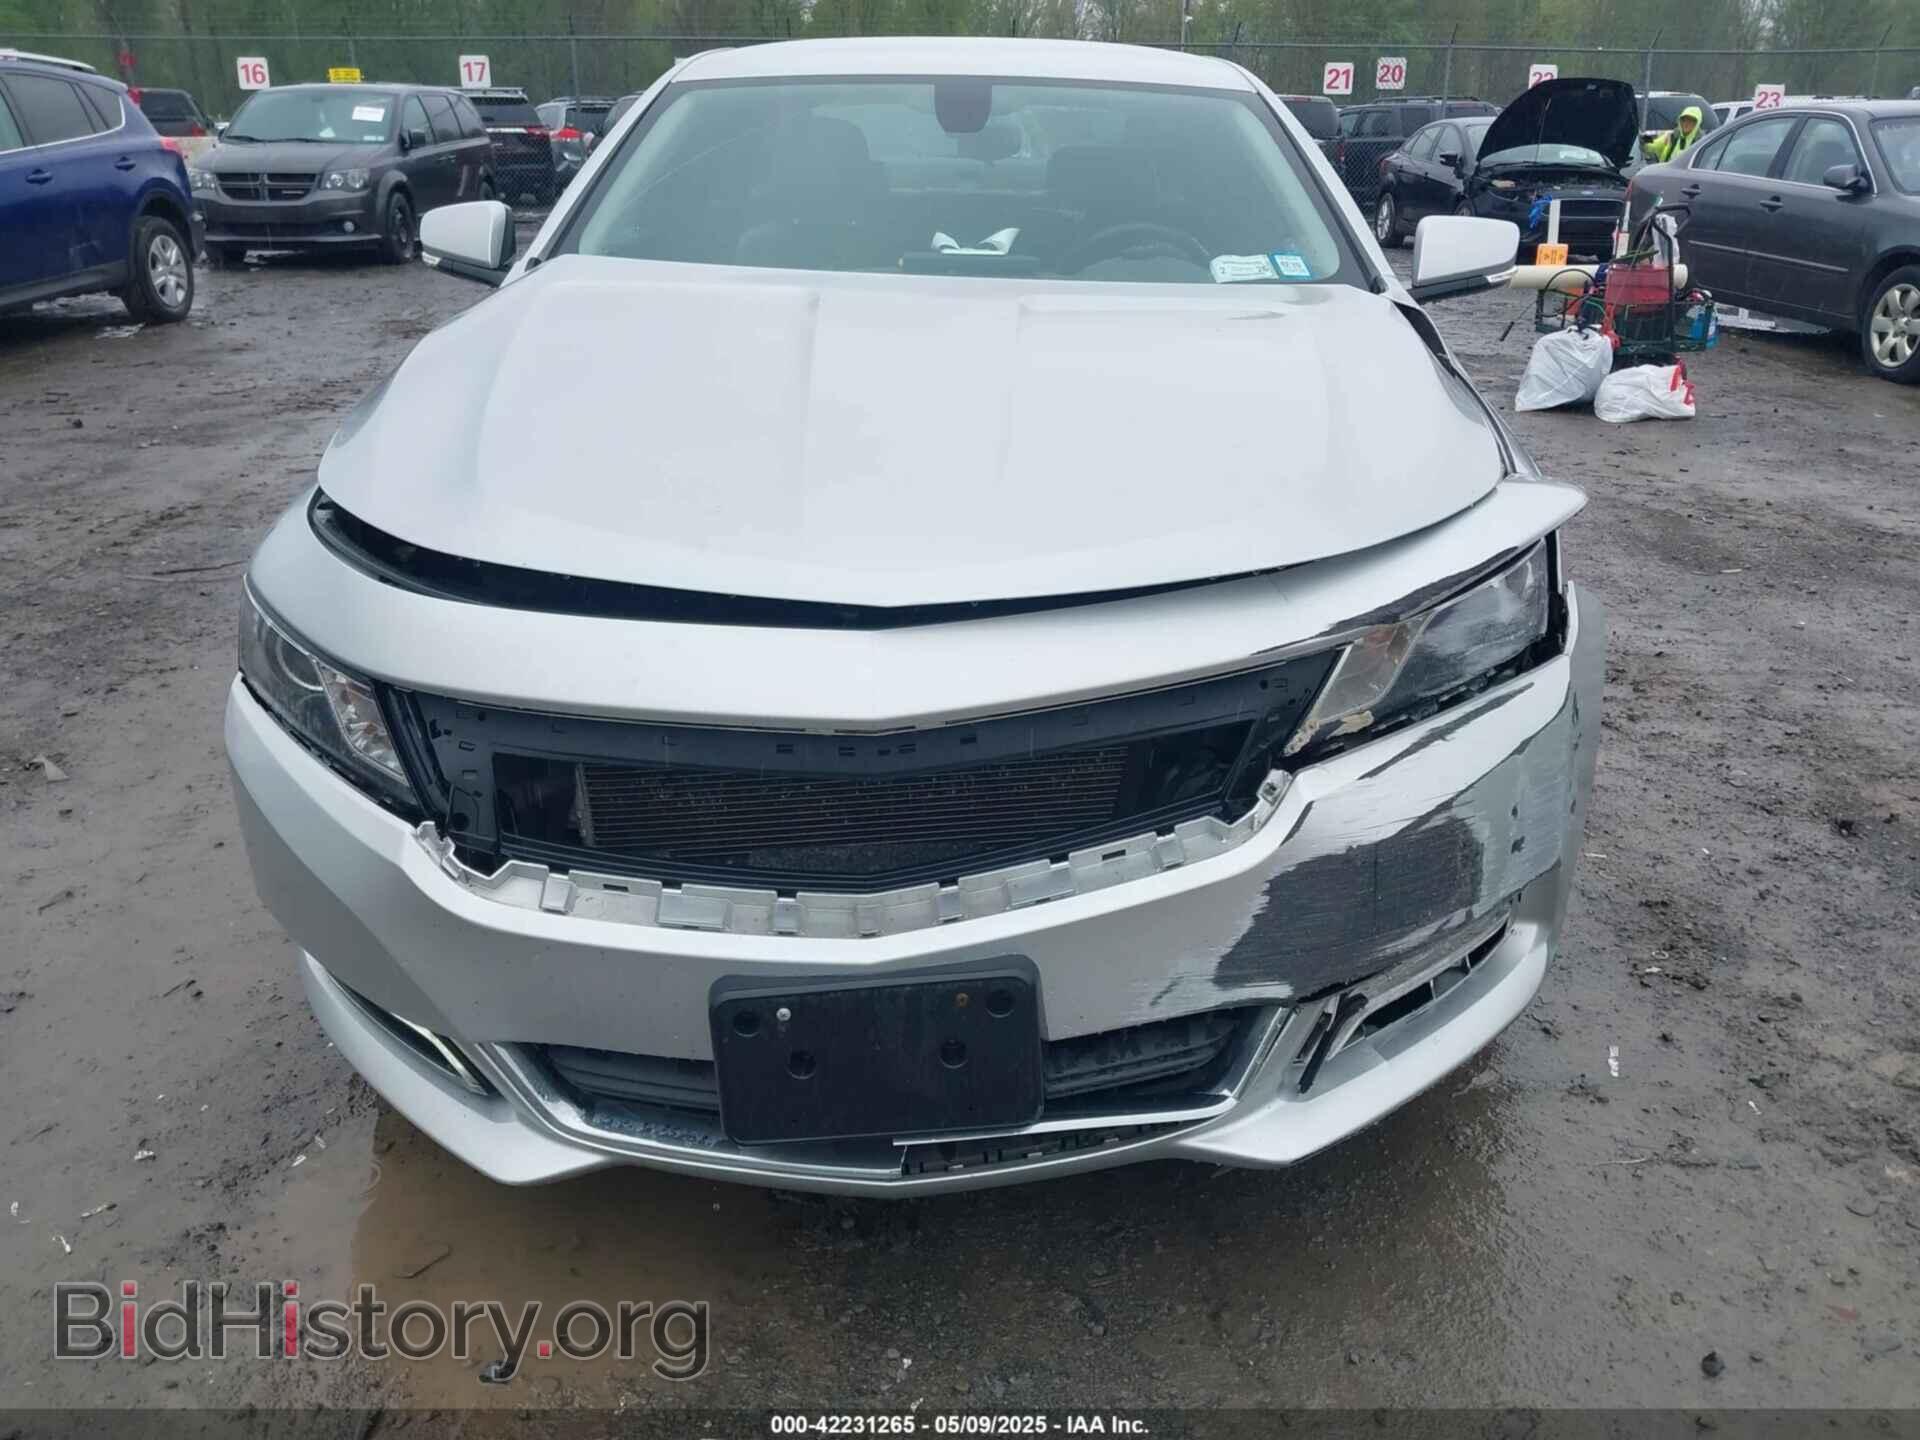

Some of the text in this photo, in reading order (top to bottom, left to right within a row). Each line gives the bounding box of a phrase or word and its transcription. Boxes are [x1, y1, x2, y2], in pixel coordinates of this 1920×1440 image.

[241, 63, 266, 84] 16
[463, 62, 486, 81] 17
[1326, 68, 1351, 89] 21
[1378, 64, 1403, 83] 20
